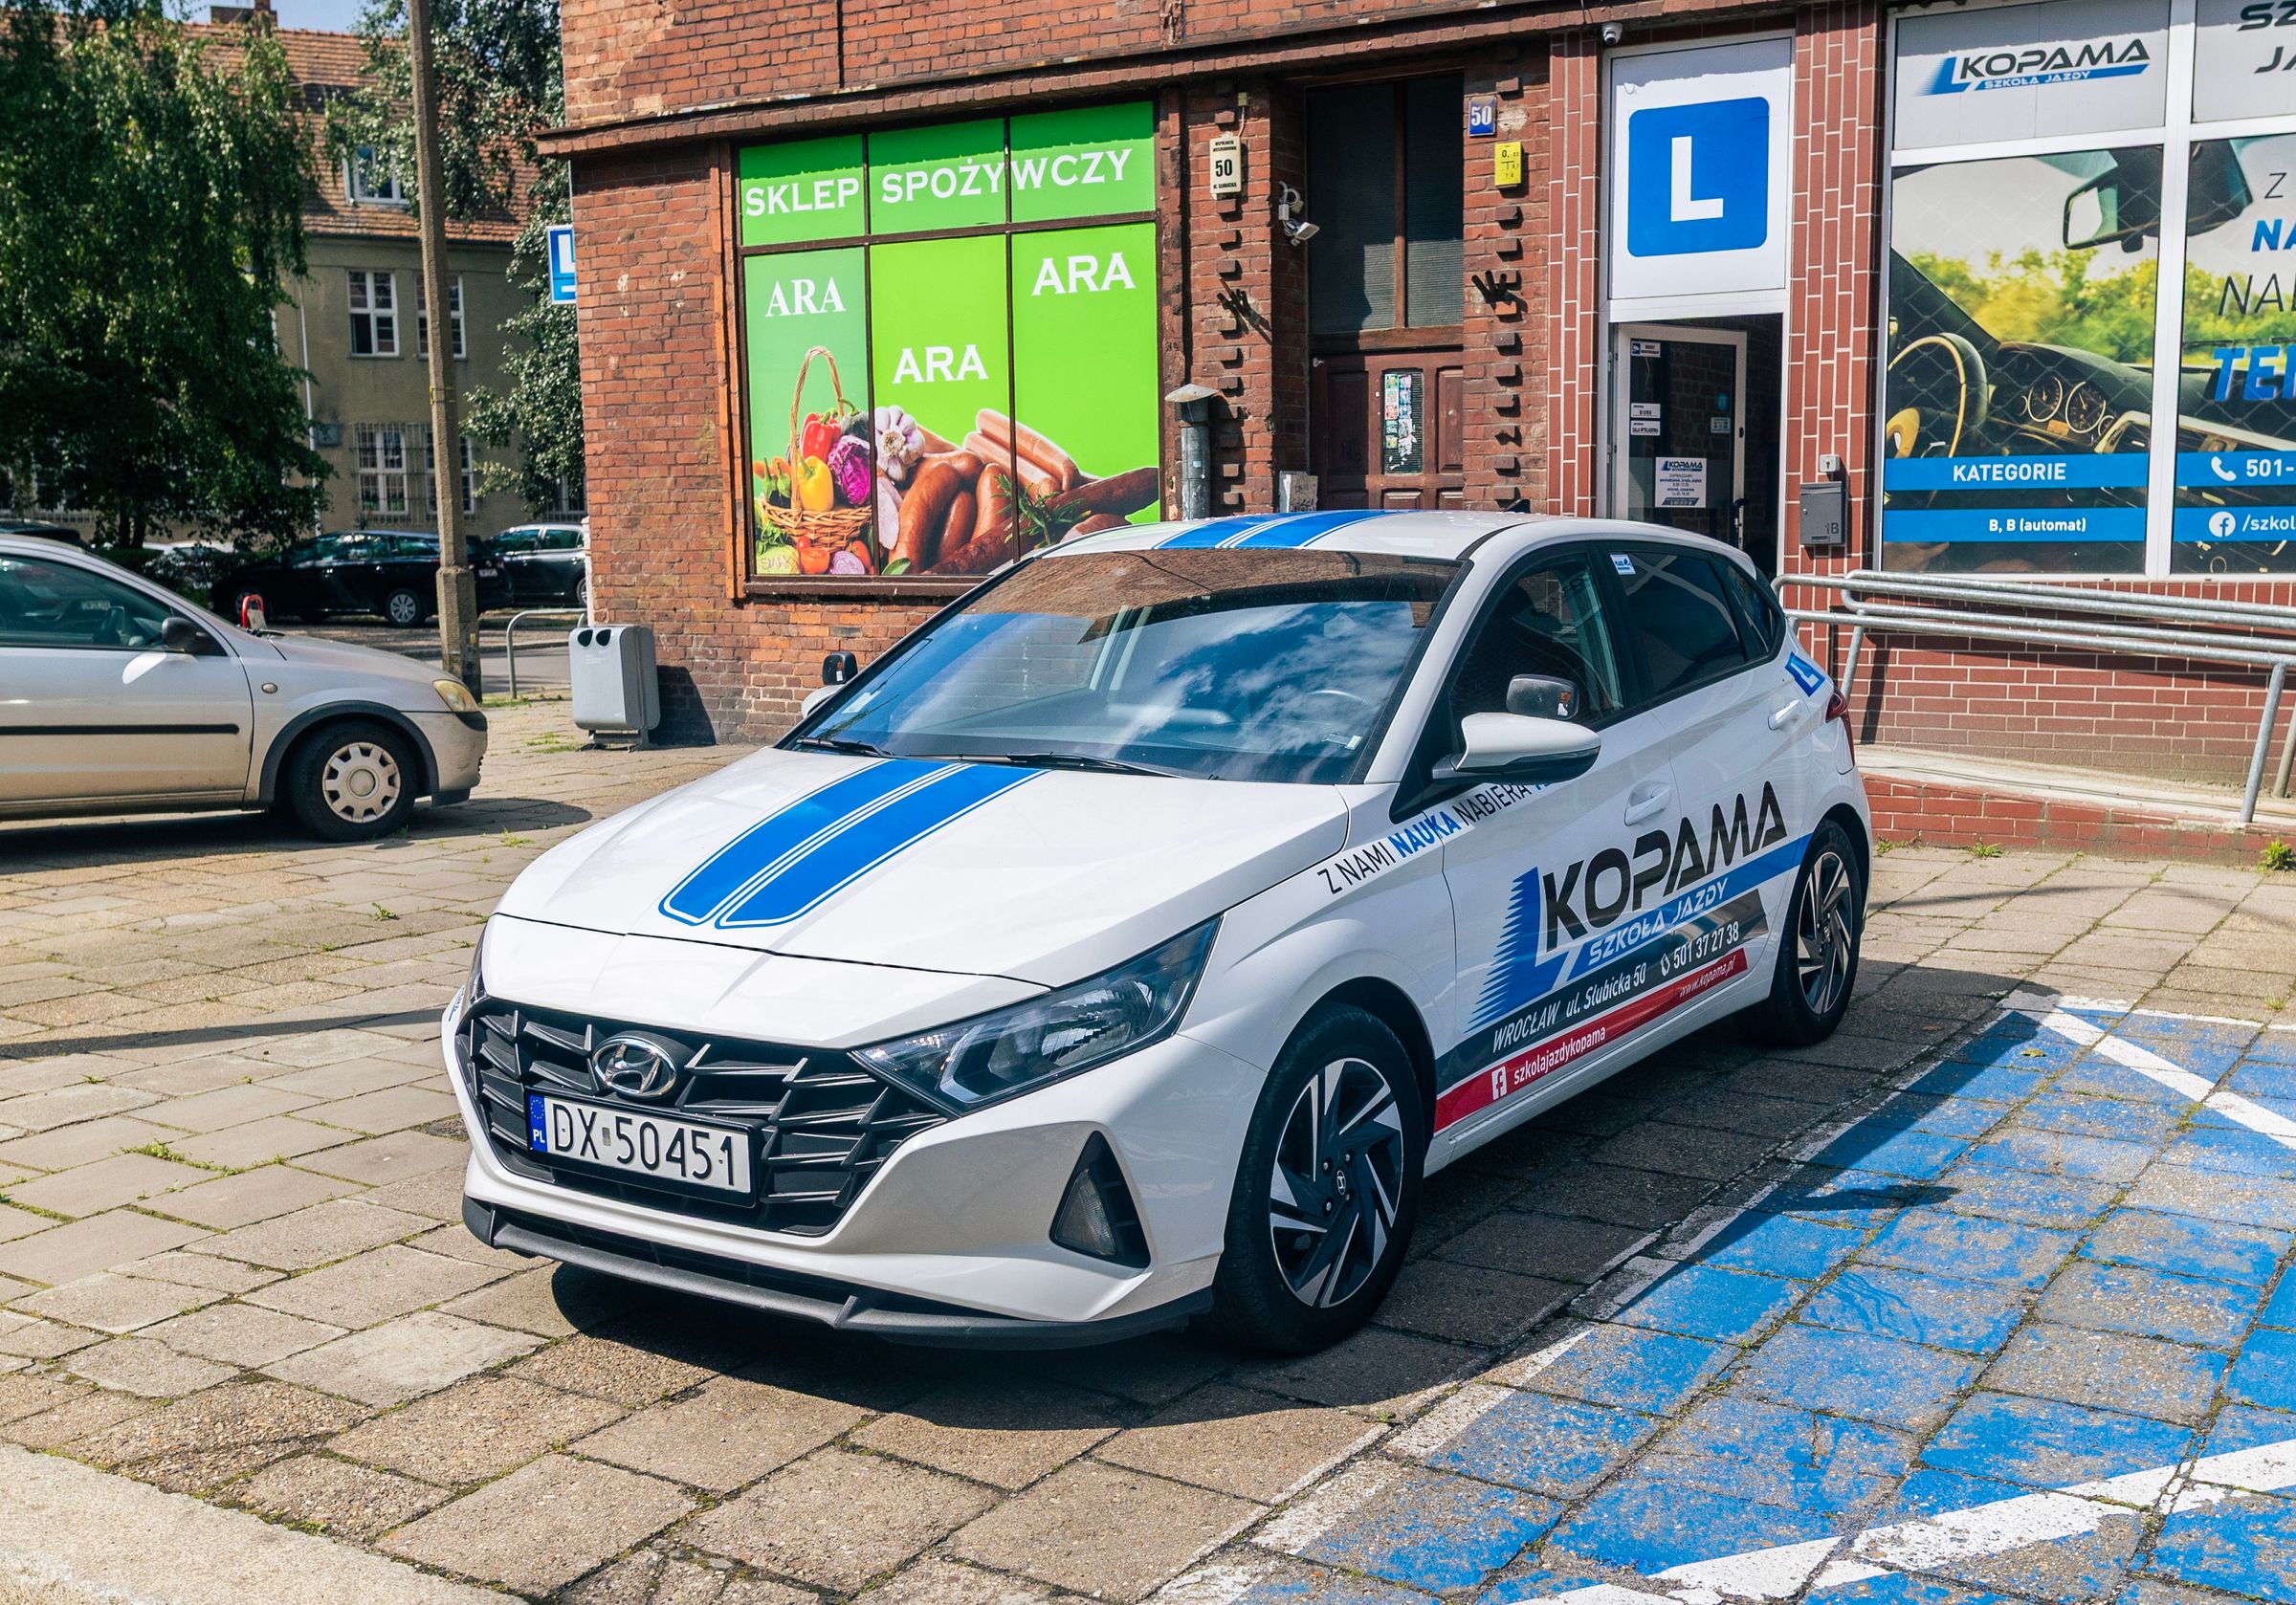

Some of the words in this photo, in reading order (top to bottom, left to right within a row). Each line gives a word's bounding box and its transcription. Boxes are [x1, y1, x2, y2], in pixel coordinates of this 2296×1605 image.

[1960, 38, 2151, 79] KOPAMA
[1984, 77, 2040, 89] SZKOŁA
[2044, 70, 2091, 84] JAZDY
[1471, 105, 1492, 125] 50
[745, 177, 860, 217] SKLEP
[881, 148, 1133, 205] SPOŻYWCZY
[1215, 159, 1232, 177] 50
[1670, 136, 1724, 222] L
[2264, 172, 2287, 199] Z
[1031, 253, 1137, 297] ARA
[2218, 274, 2296, 316] NA
[765, 276, 846, 318] ARA
[893, 343, 989, 385] ARA
[1953, 462, 2067, 482] KATEGORIE
[1824, 521, 1839, 535] 1B
[1989, 518, 2003, 534] B,
[2006, 518, 2017, 532] B
[2020, 517, 2086, 533] (automat)
[1316, 868, 1342, 894] Z
[1335, 841, 1397, 886] NAMI
[1387, 810, 1462, 858] NAUKA
[1451, 782, 1532, 826] NABIERA
[1543, 781, 1788, 953] KOPAMA
[1588, 910, 1665, 966] SZKOŁA
[1672, 877, 1729, 924] JAZDY
[1673, 943, 1692, 969] 501
[1695, 932, 1711, 958] 37
[1711, 929, 1725, 953] 27
[1726, 921, 1739, 945] 38
[1679, 955, 1736, 999] www.kopama.pl
[1492, 1000, 1560, 1053] WROCŁAW
[1566, 992, 1580, 1018] ul.
[1633, 962, 1647, 986] 50
[1513, 1026, 1606, 1086] szkolajazdykopama
[532, 1129, 545, 1144] PL
[552, 1103, 600, 1160] DX
[614, 1115, 735, 1187] 50451
